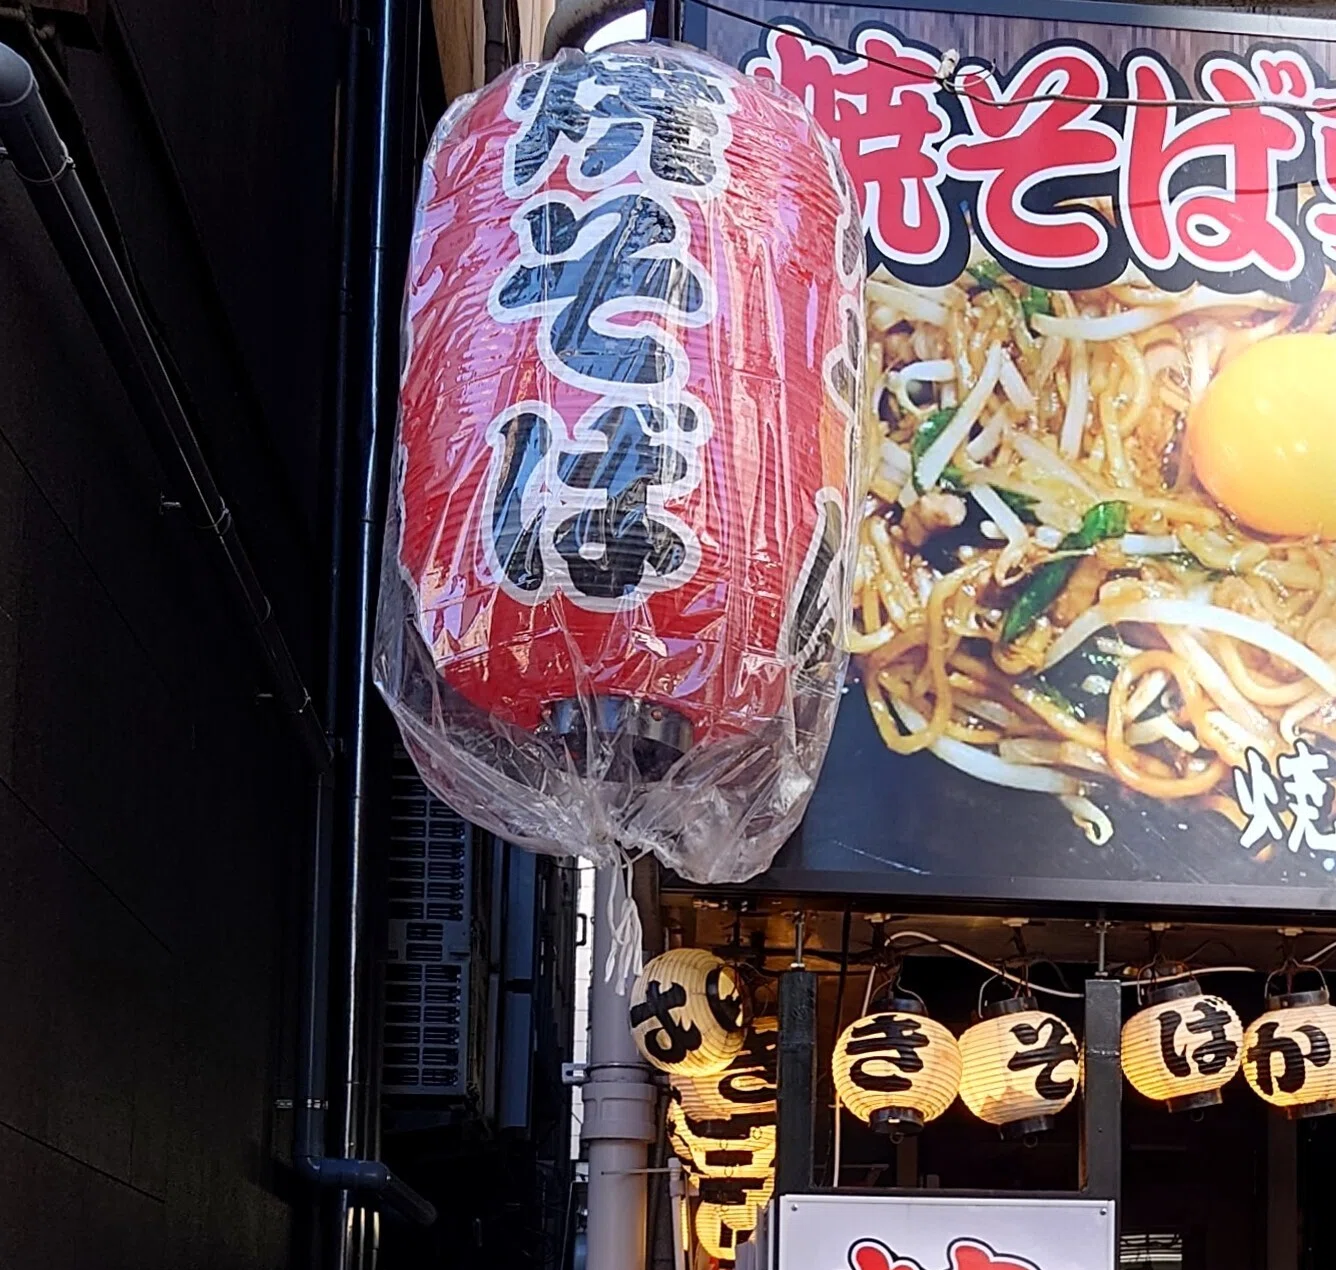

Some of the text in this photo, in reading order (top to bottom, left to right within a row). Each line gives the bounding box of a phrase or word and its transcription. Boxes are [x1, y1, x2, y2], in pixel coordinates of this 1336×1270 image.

[488, 58, 735, 612] 焼そば
[844, 1014, 931, 1093] き
[1006, 1017, 1079, 1100] そ
[1246, 1020, 1333, 1095] か
